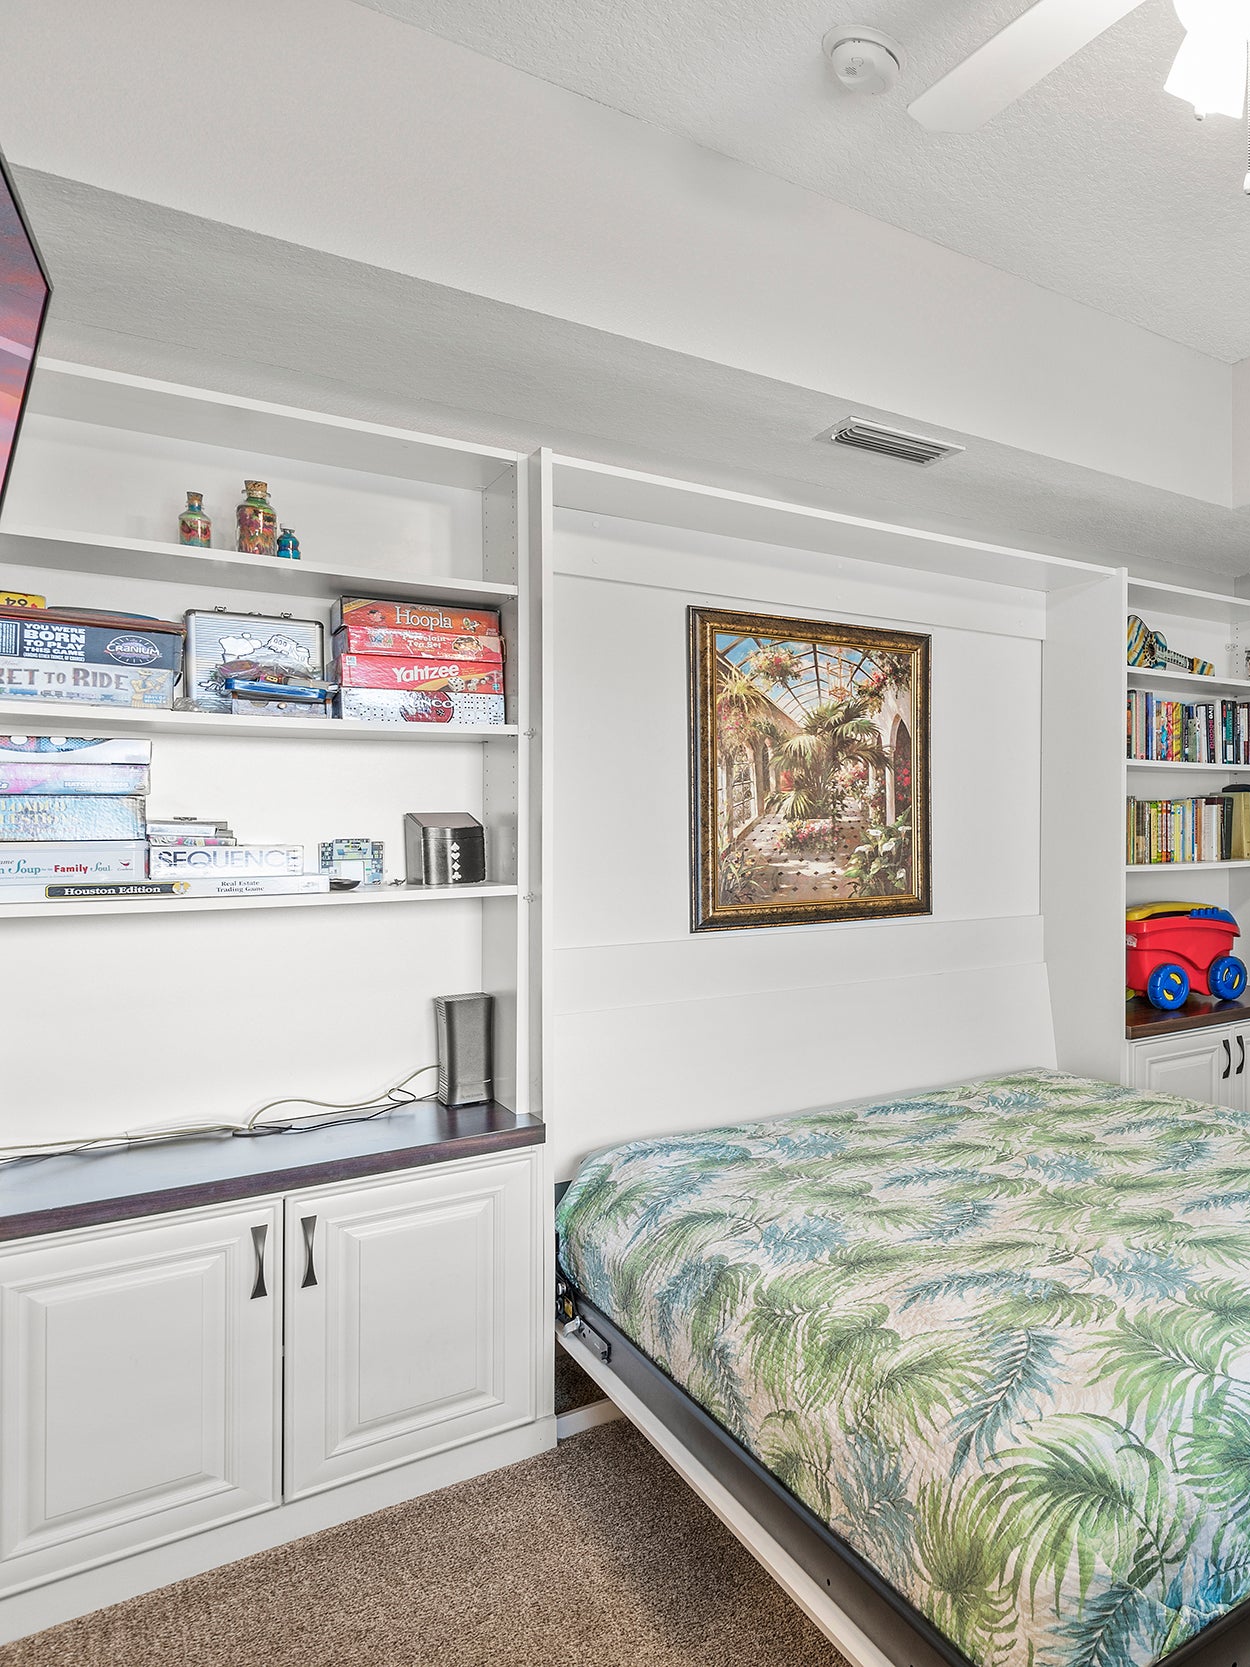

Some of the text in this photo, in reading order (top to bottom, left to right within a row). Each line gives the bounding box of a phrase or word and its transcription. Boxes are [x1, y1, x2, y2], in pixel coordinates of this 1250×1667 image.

[394, 605, 454, 632] Hoopla
[23, 622, 86, 634] YOU WERE
[23, 629, 86, 645] BORN
[23, 639, 86, 651] TO PLAY
[407, 640, 426, 650] Tea
[427, 641, 442, 650] Set
[52, 648, 86, 657] GAME
[44, 671, 67, 684] TO
[72, 667, 129, 692] RIDE
[392, 664, 459, 682] Yahtzee
[158, 850, 300, 869] SEQUENCE
[8, 858, 42, 876] Soup
[54, 863, 89, 874] Family
[90, 861, 111, 873] Soul
[64, 885, 162, 896] Houston Edition
[217, 885, 265, 894] Trading Game
